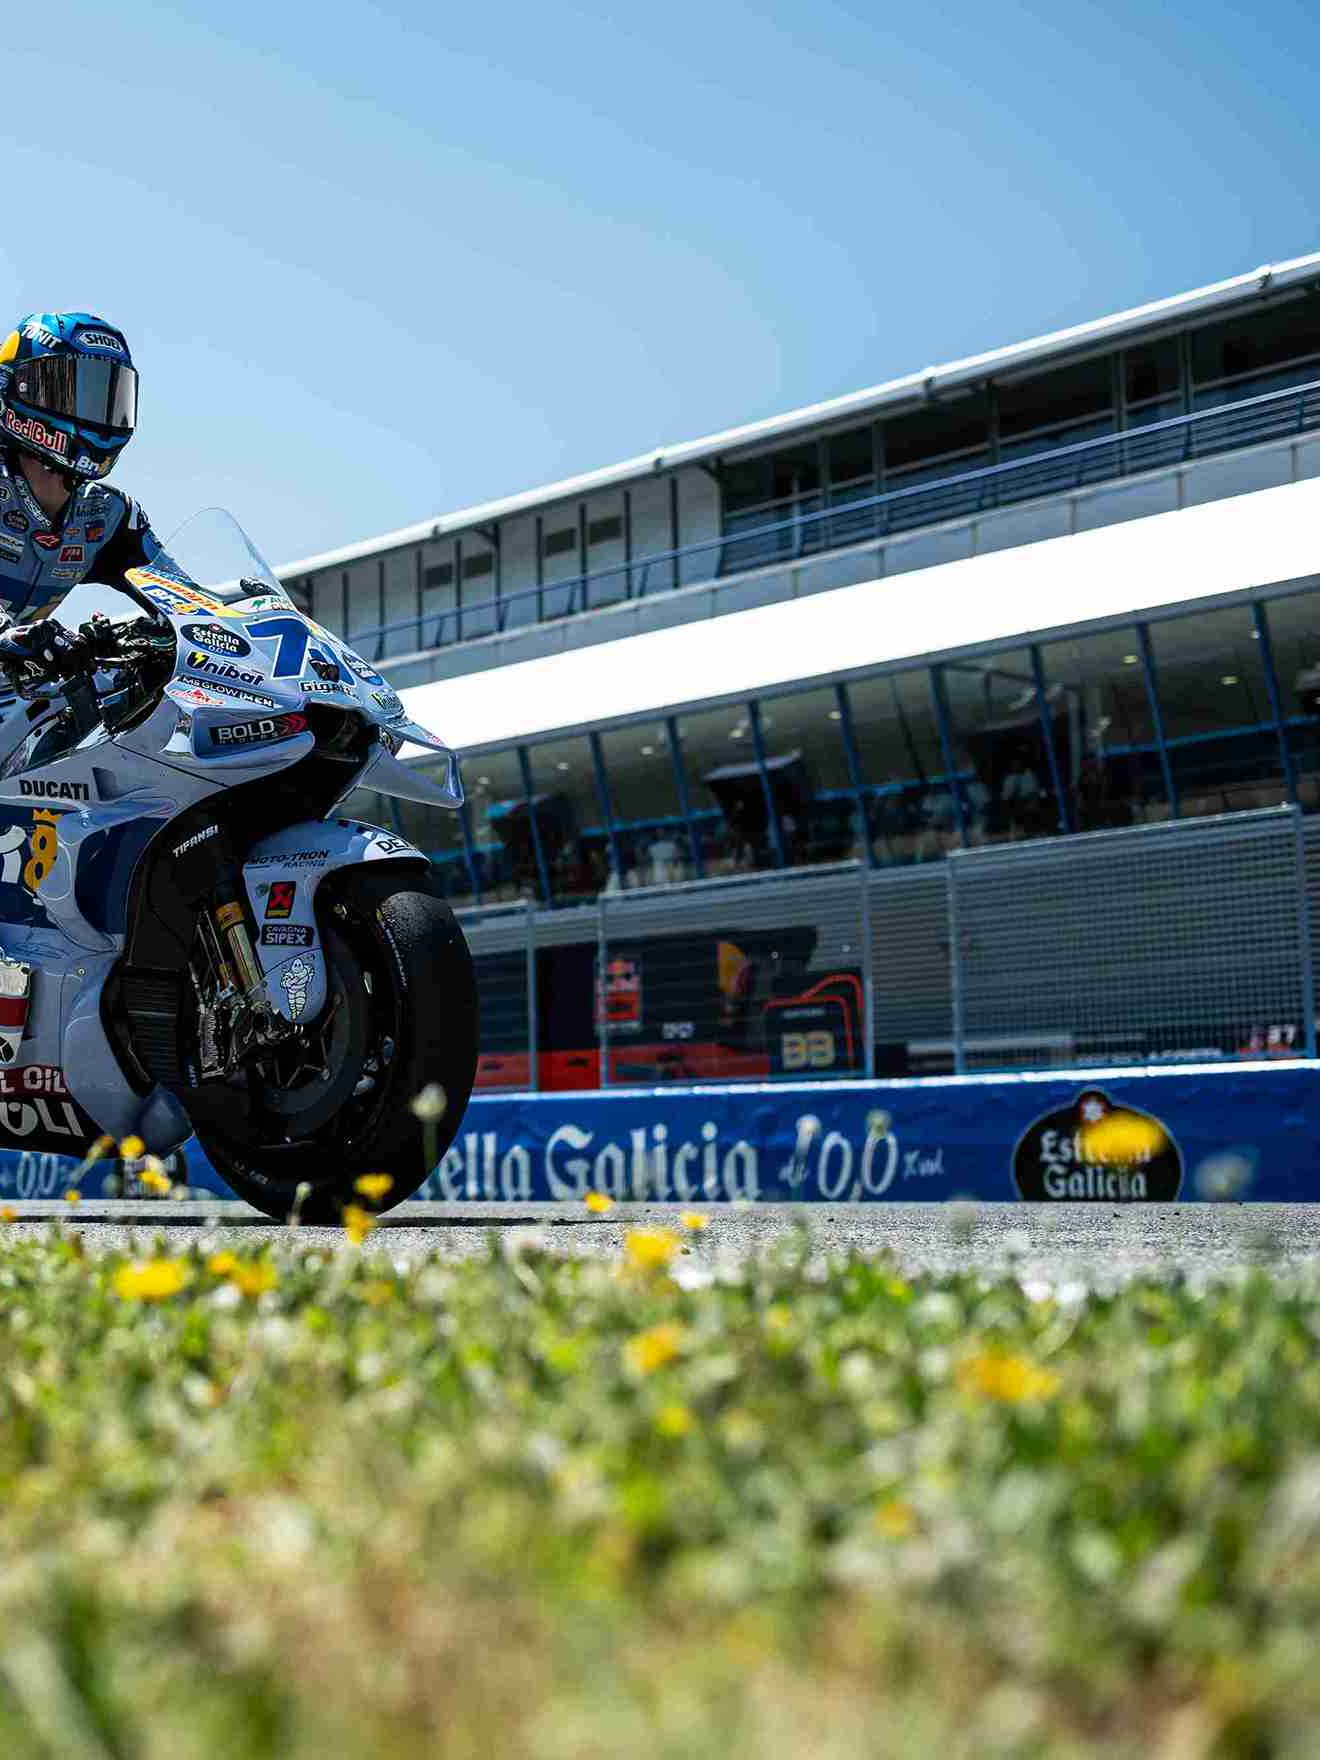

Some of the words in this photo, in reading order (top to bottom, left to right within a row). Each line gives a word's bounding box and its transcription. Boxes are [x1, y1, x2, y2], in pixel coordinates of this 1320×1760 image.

[7, 408, 33, 440] Red
[32, 421, 67, 454] Bull
[191, 625, 240, 645] Estrella
[193, 633, 238, 652] Galicia
[201, 681, 238, 696] GLOW
[218, 720, 275, 740] BOLD
[19, 779, 89, 800] DUCATI
[266, 933, 307, 945] SIPEX
[22, 1067, 67, 1093] OIL
[422, 1131, 535, 1201] ella
[545, 1122, 762, 1201] Galicia
[1043, 1163, 1147, 1199] Galicia
